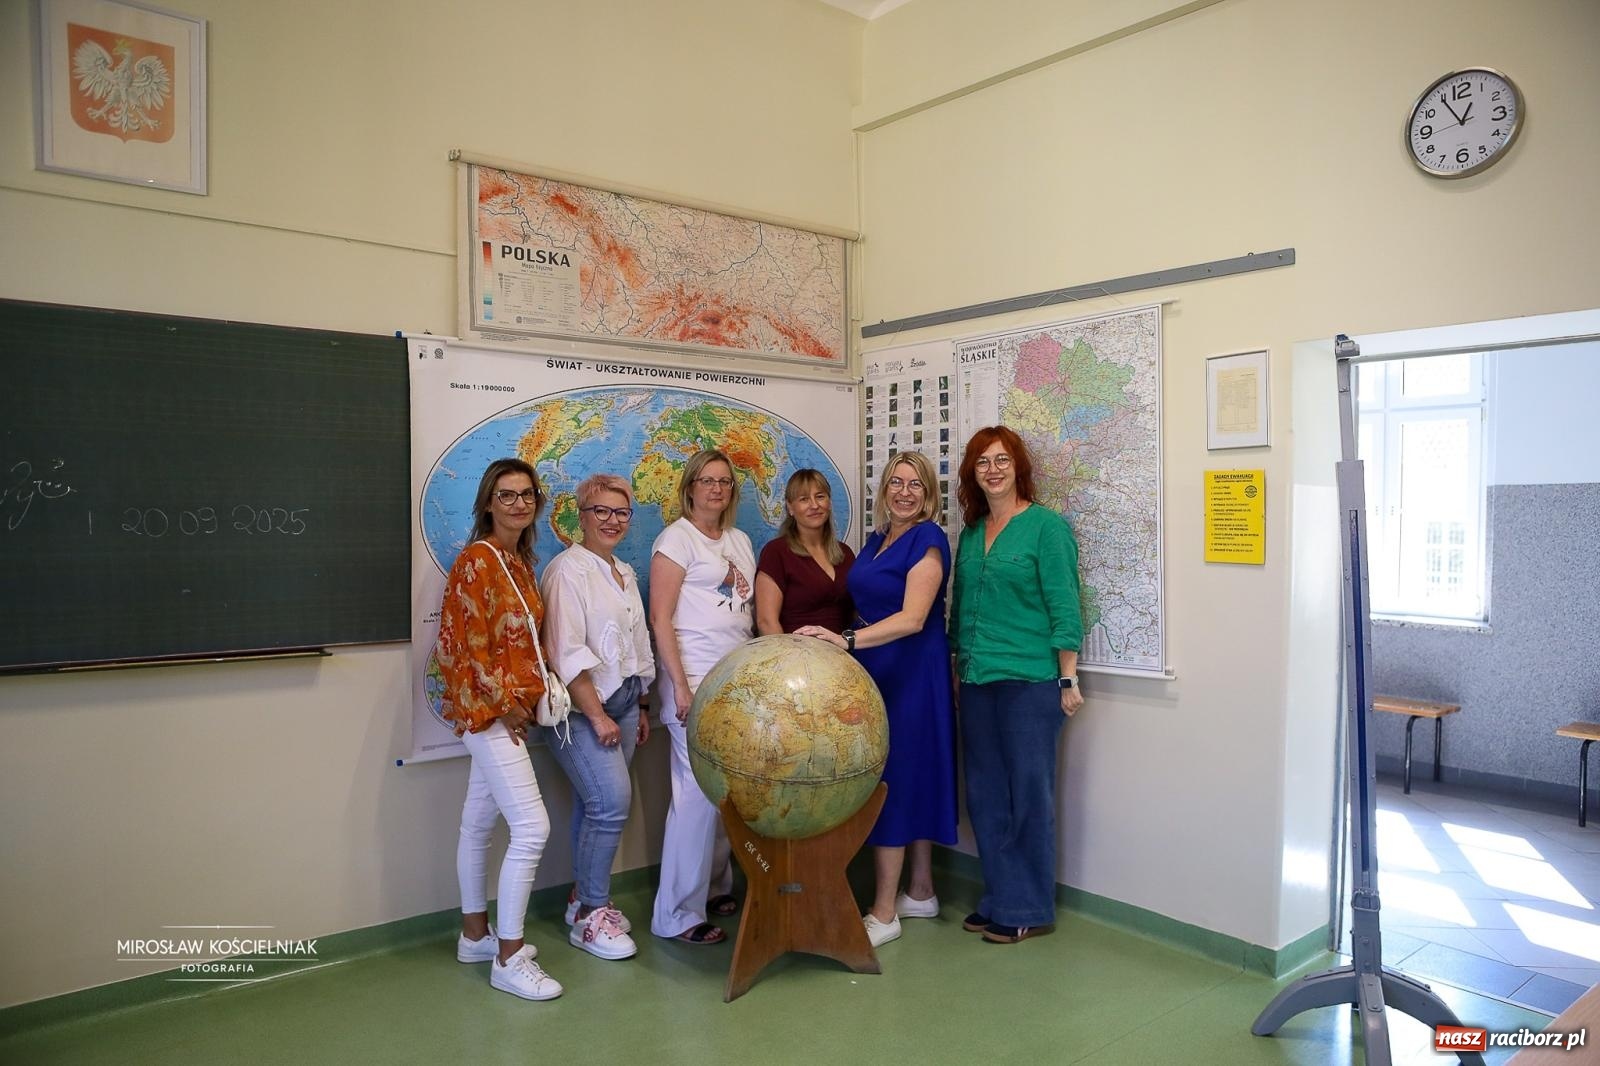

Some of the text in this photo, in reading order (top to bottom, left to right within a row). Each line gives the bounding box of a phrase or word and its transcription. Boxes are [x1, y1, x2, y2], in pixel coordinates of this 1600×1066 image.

[1452, 82, 1473, 101] 12
[1491, 91, 1501, 102] 2
[1425, 108, 1436, 120] 10
[1491, 105, 1508, 122] 3
[1419, 125, 1433, 140] 9
[1491, 129, 1500, 137] 4
[1425, 144, 1435, 154] 8
[1455, 148, 1470, 163] 6
[1478, 145, 1487, 154] 5
[1439, 154, 1446, 164] 7
[501, 244, 571, 268] POLSKA
[960, 348, 997, 364] ŚLĄSKIE
[546, 357, 583, 371] ŚWIAT
[595, 363, 692, 380] UKSZTAŁTOWANIE
[696, 372, 767, 386] POWIERZCHNI
[122, 507, 169, 538] 20
[180, 506, 218, 536] 09
[232, 505, 310, 536] 2025
